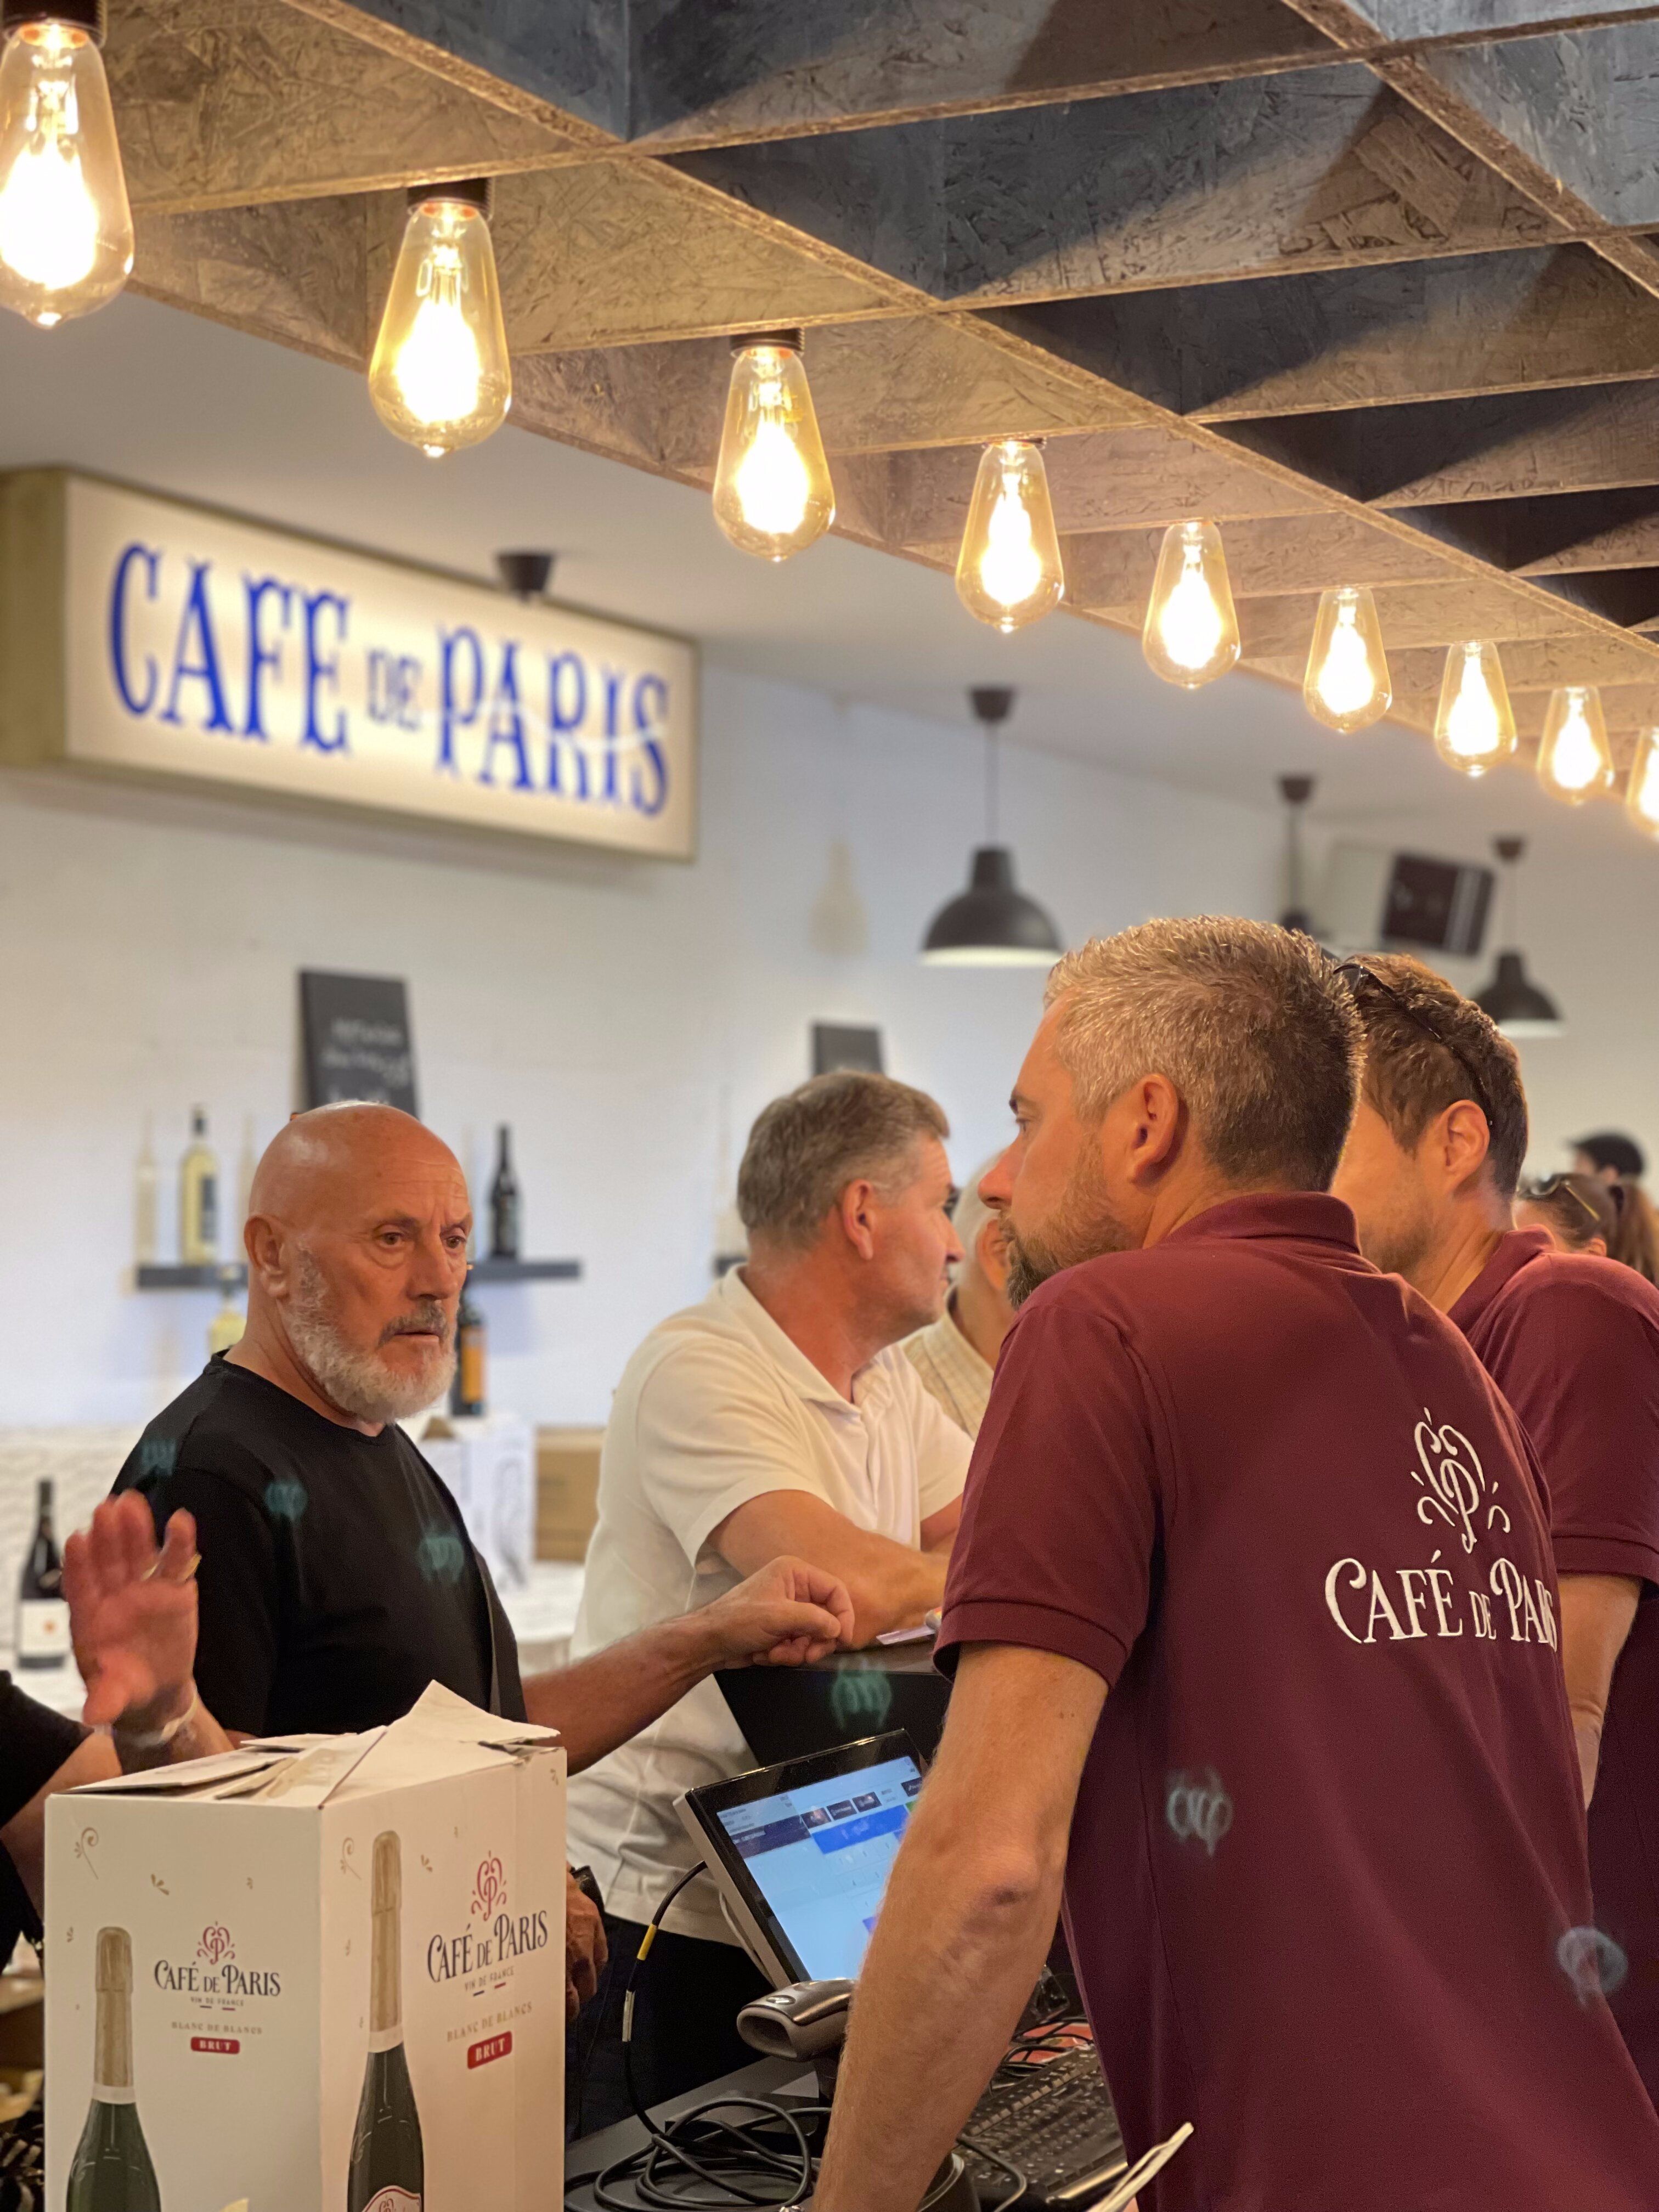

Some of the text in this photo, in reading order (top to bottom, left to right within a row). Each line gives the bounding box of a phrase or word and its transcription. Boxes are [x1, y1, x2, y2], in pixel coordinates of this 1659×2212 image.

[107, 542, 669, 817] CAFE DE PARIS
[1324, 1549, 1463, 1644] CAFÉ
[1469, 1590, 1497, 1640] DE
[427, 1910, 548, 1983] CAFÉ DE PARIS
[154, 1959, 281, 1997] CAFÉ DE PARIS
[465, 1966, 515, 1990] VIN DE FRANCE
[217, 1998, 245, 2007] FRANCE
[171, 2021, 263, 2035] BLANC DE BLANCS
[447, 2001, 533, 2042] BLANC DE BLANCS
[199, 2039, 232, 2051] BRUT
[475, 2037, 505, 2062] BRUT
